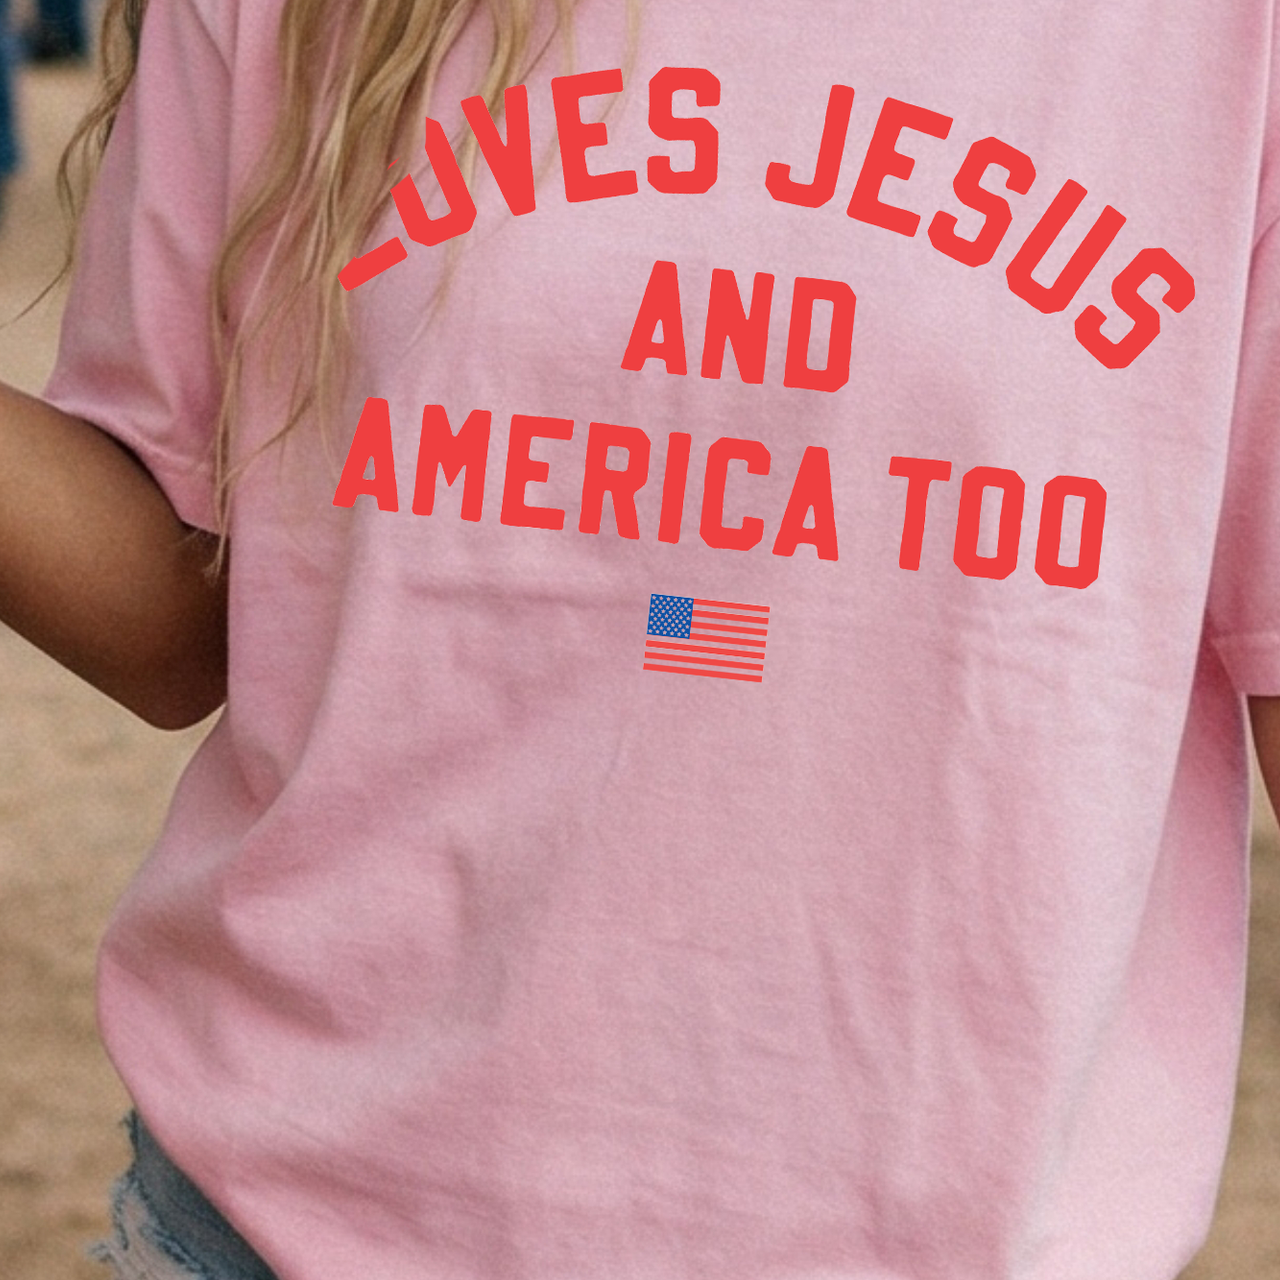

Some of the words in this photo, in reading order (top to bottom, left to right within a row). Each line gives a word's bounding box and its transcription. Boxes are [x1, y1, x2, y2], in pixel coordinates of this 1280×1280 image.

[764, 84, 1196, 370] JESUS
[620, 260, 857, 393] AND
[331, 396, 839, 562] AMERICA
[888, 455, 1107, 590] TOO
